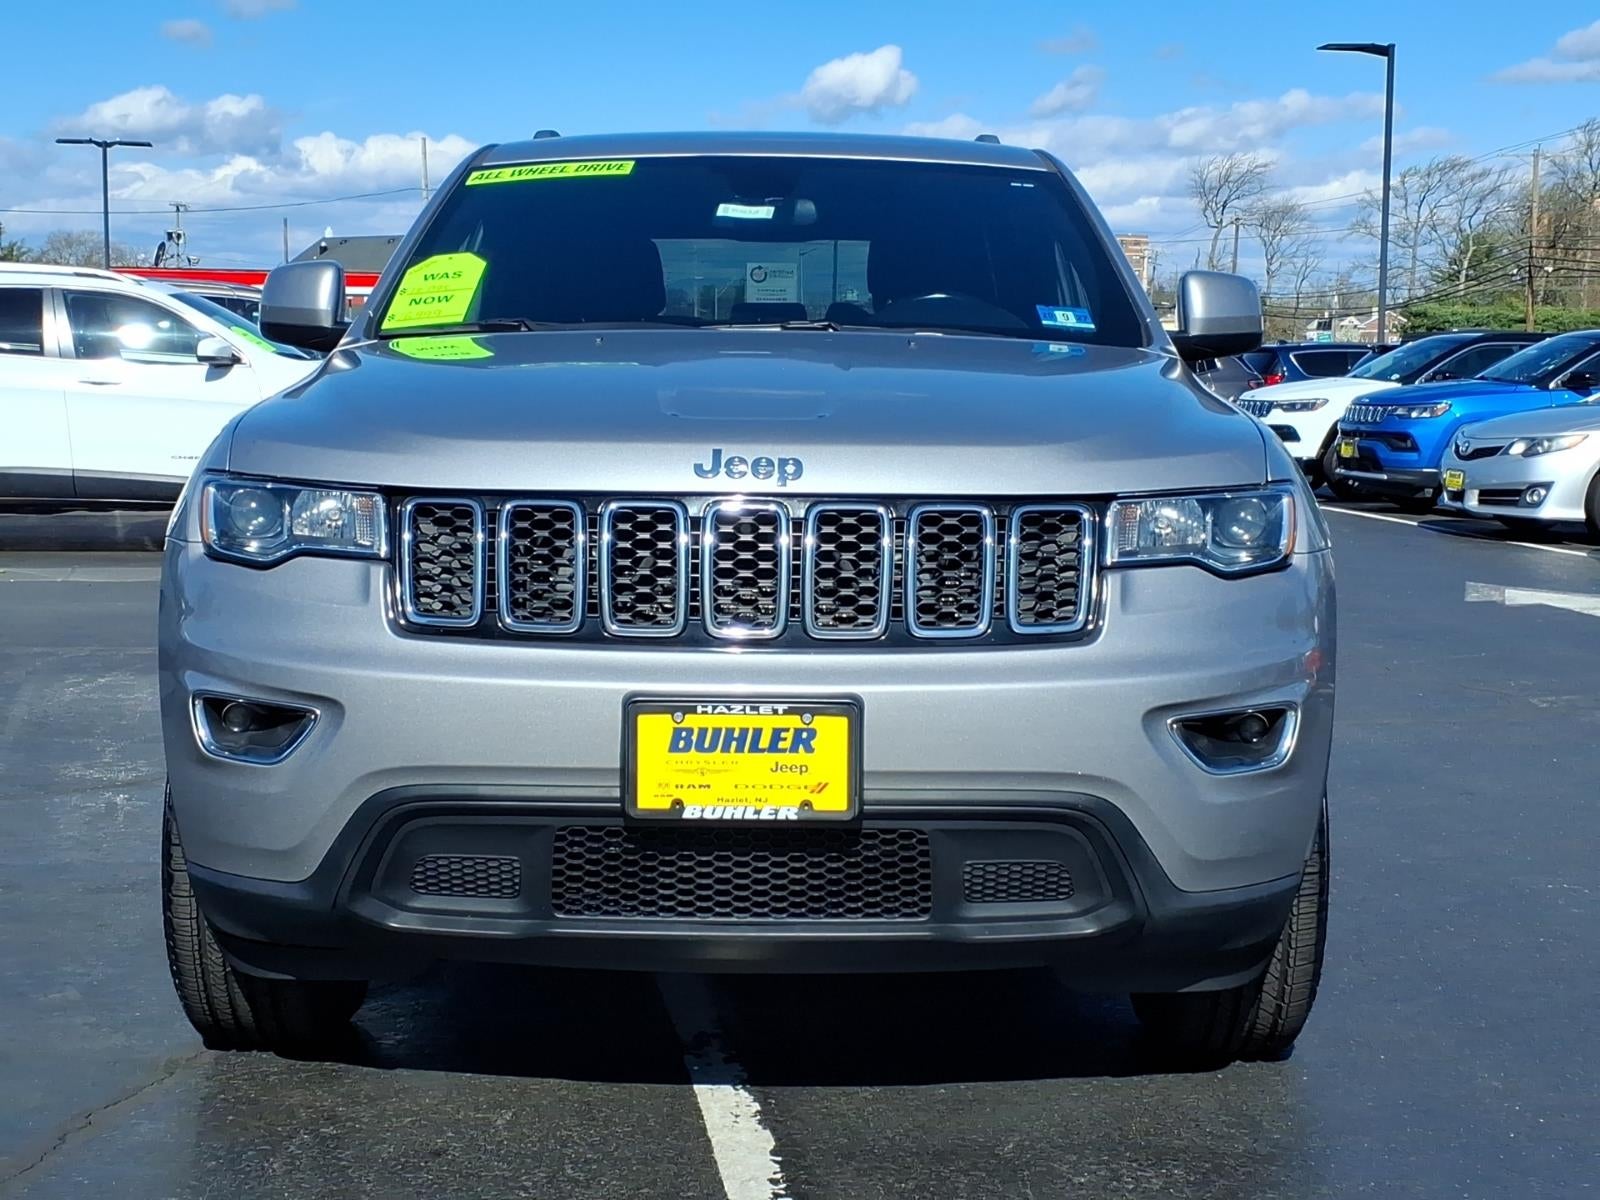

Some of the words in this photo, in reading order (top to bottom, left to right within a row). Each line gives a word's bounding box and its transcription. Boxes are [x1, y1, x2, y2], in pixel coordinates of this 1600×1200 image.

[472, 172, 505, 182] ALL
[508, 164, 571, 178] WHEEL
[574, 162, 630, 173] DRIVE
[423, 270, 463, 281] WAS
[408, 294, 455, 307] NOW
[693, 448, 804, 487] Jeep
[696, 704, 789, 715] HAZLET
[668, 726, 818, 754] BUHLER
[770, 761, 809, 775] Jeep
[682, 805, 799, 821] BUHLER
